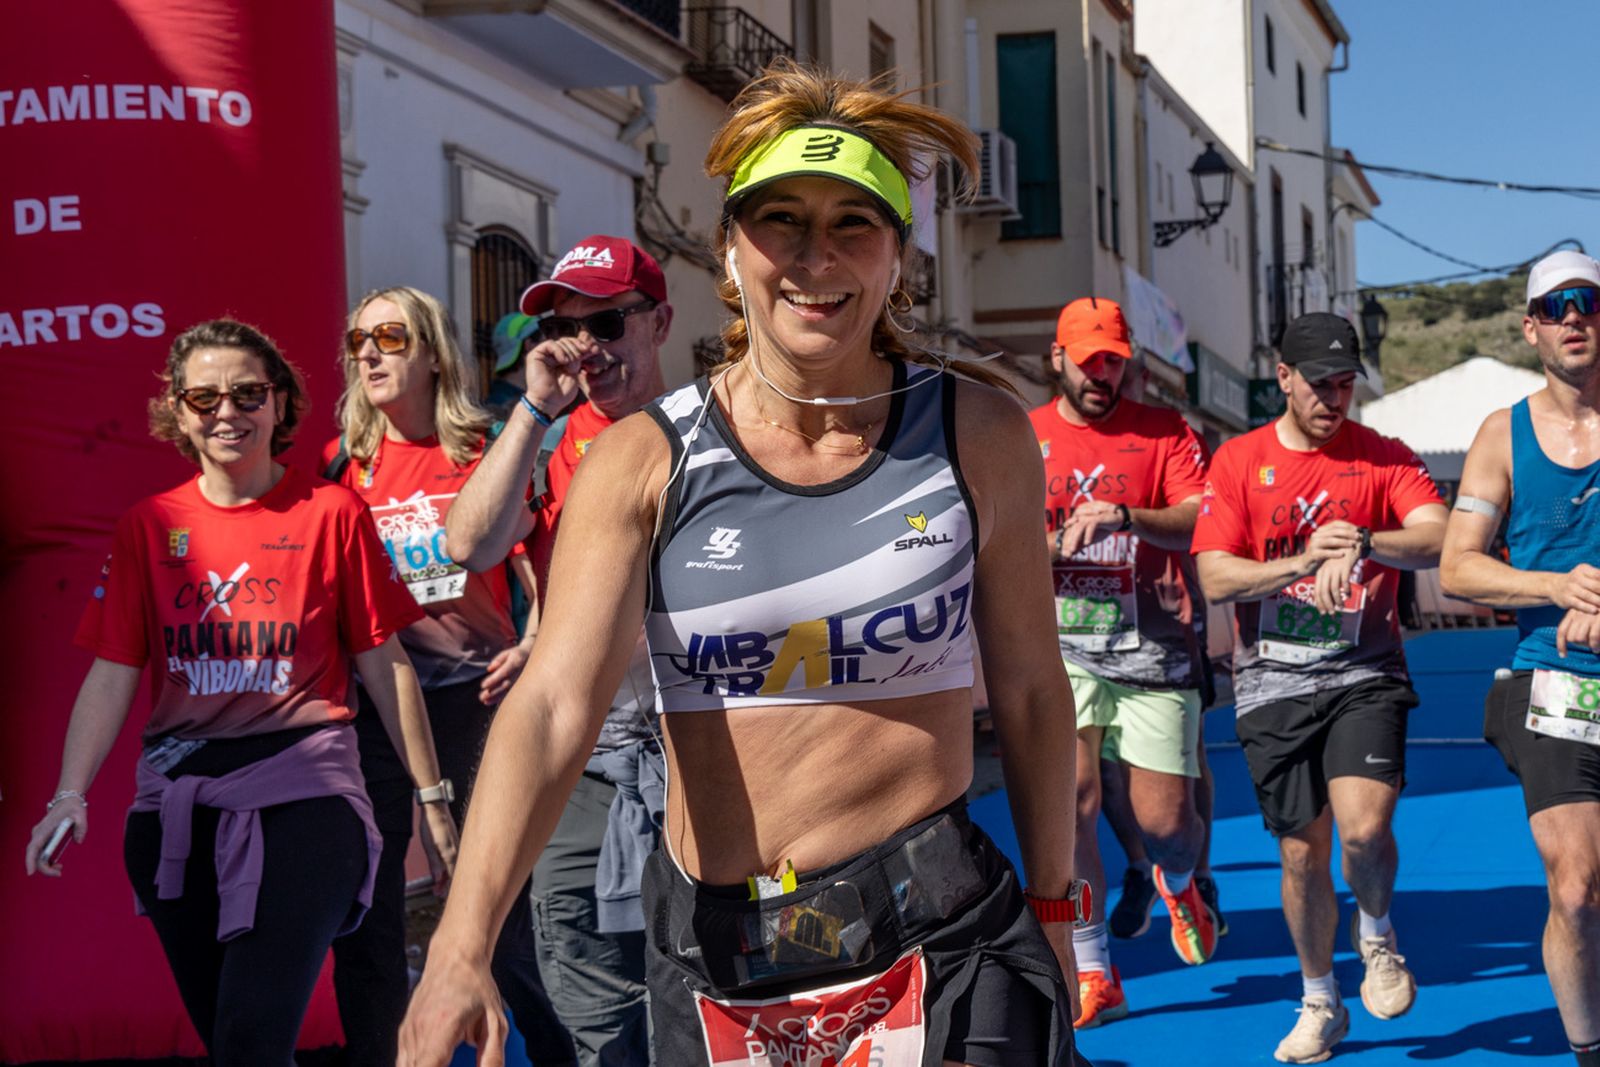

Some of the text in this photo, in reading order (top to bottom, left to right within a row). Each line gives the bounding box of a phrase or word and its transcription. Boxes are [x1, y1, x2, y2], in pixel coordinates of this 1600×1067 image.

[13, 195, 82, 235] DE
[0, 302, 166, 348] ARTOS
[1048, 474, 1129, 496] CROSS
[894, 533, 953, 552] SPALL
[685, 560, 744, 571] grafisport
[1061, 573, 1122, 588] X CROSS
[174, 577, 282, 609] CROSS
[163, 620, 299, 659] PANTANO
[184, 652, 293, 696] VÍBORAS
[778, 986, 891, 1042] CROSS
